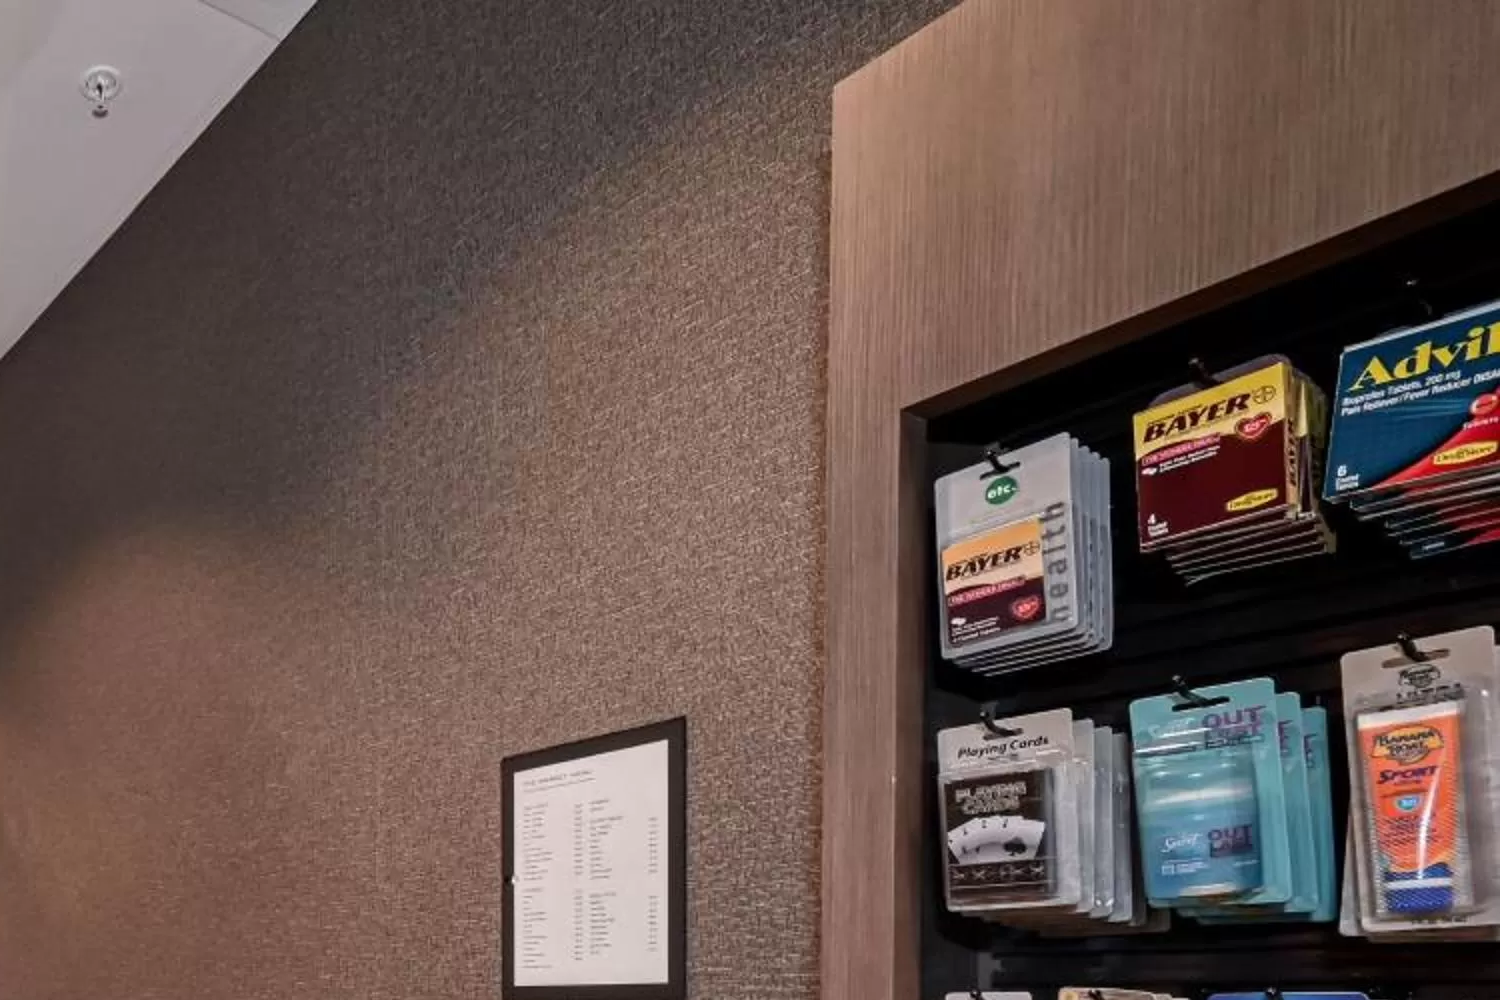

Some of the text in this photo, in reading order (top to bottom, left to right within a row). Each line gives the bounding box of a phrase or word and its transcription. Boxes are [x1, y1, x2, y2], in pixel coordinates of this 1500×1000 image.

[1348, 320, 1500, 392] Advil
[1425, 374, 1445, 386] 200
[1143, 393, 1251, 443] BAYER
[987, 484, 1018, 500] etc.
[946, 546, 1024, 581] BAYER
[1039, 501, 1070, 622] health
[1202, 705, 1267, 727] OUT
[957, 735, 1049, 758] Playing Cards
[1377, 764, 1440, 785] SPORT
